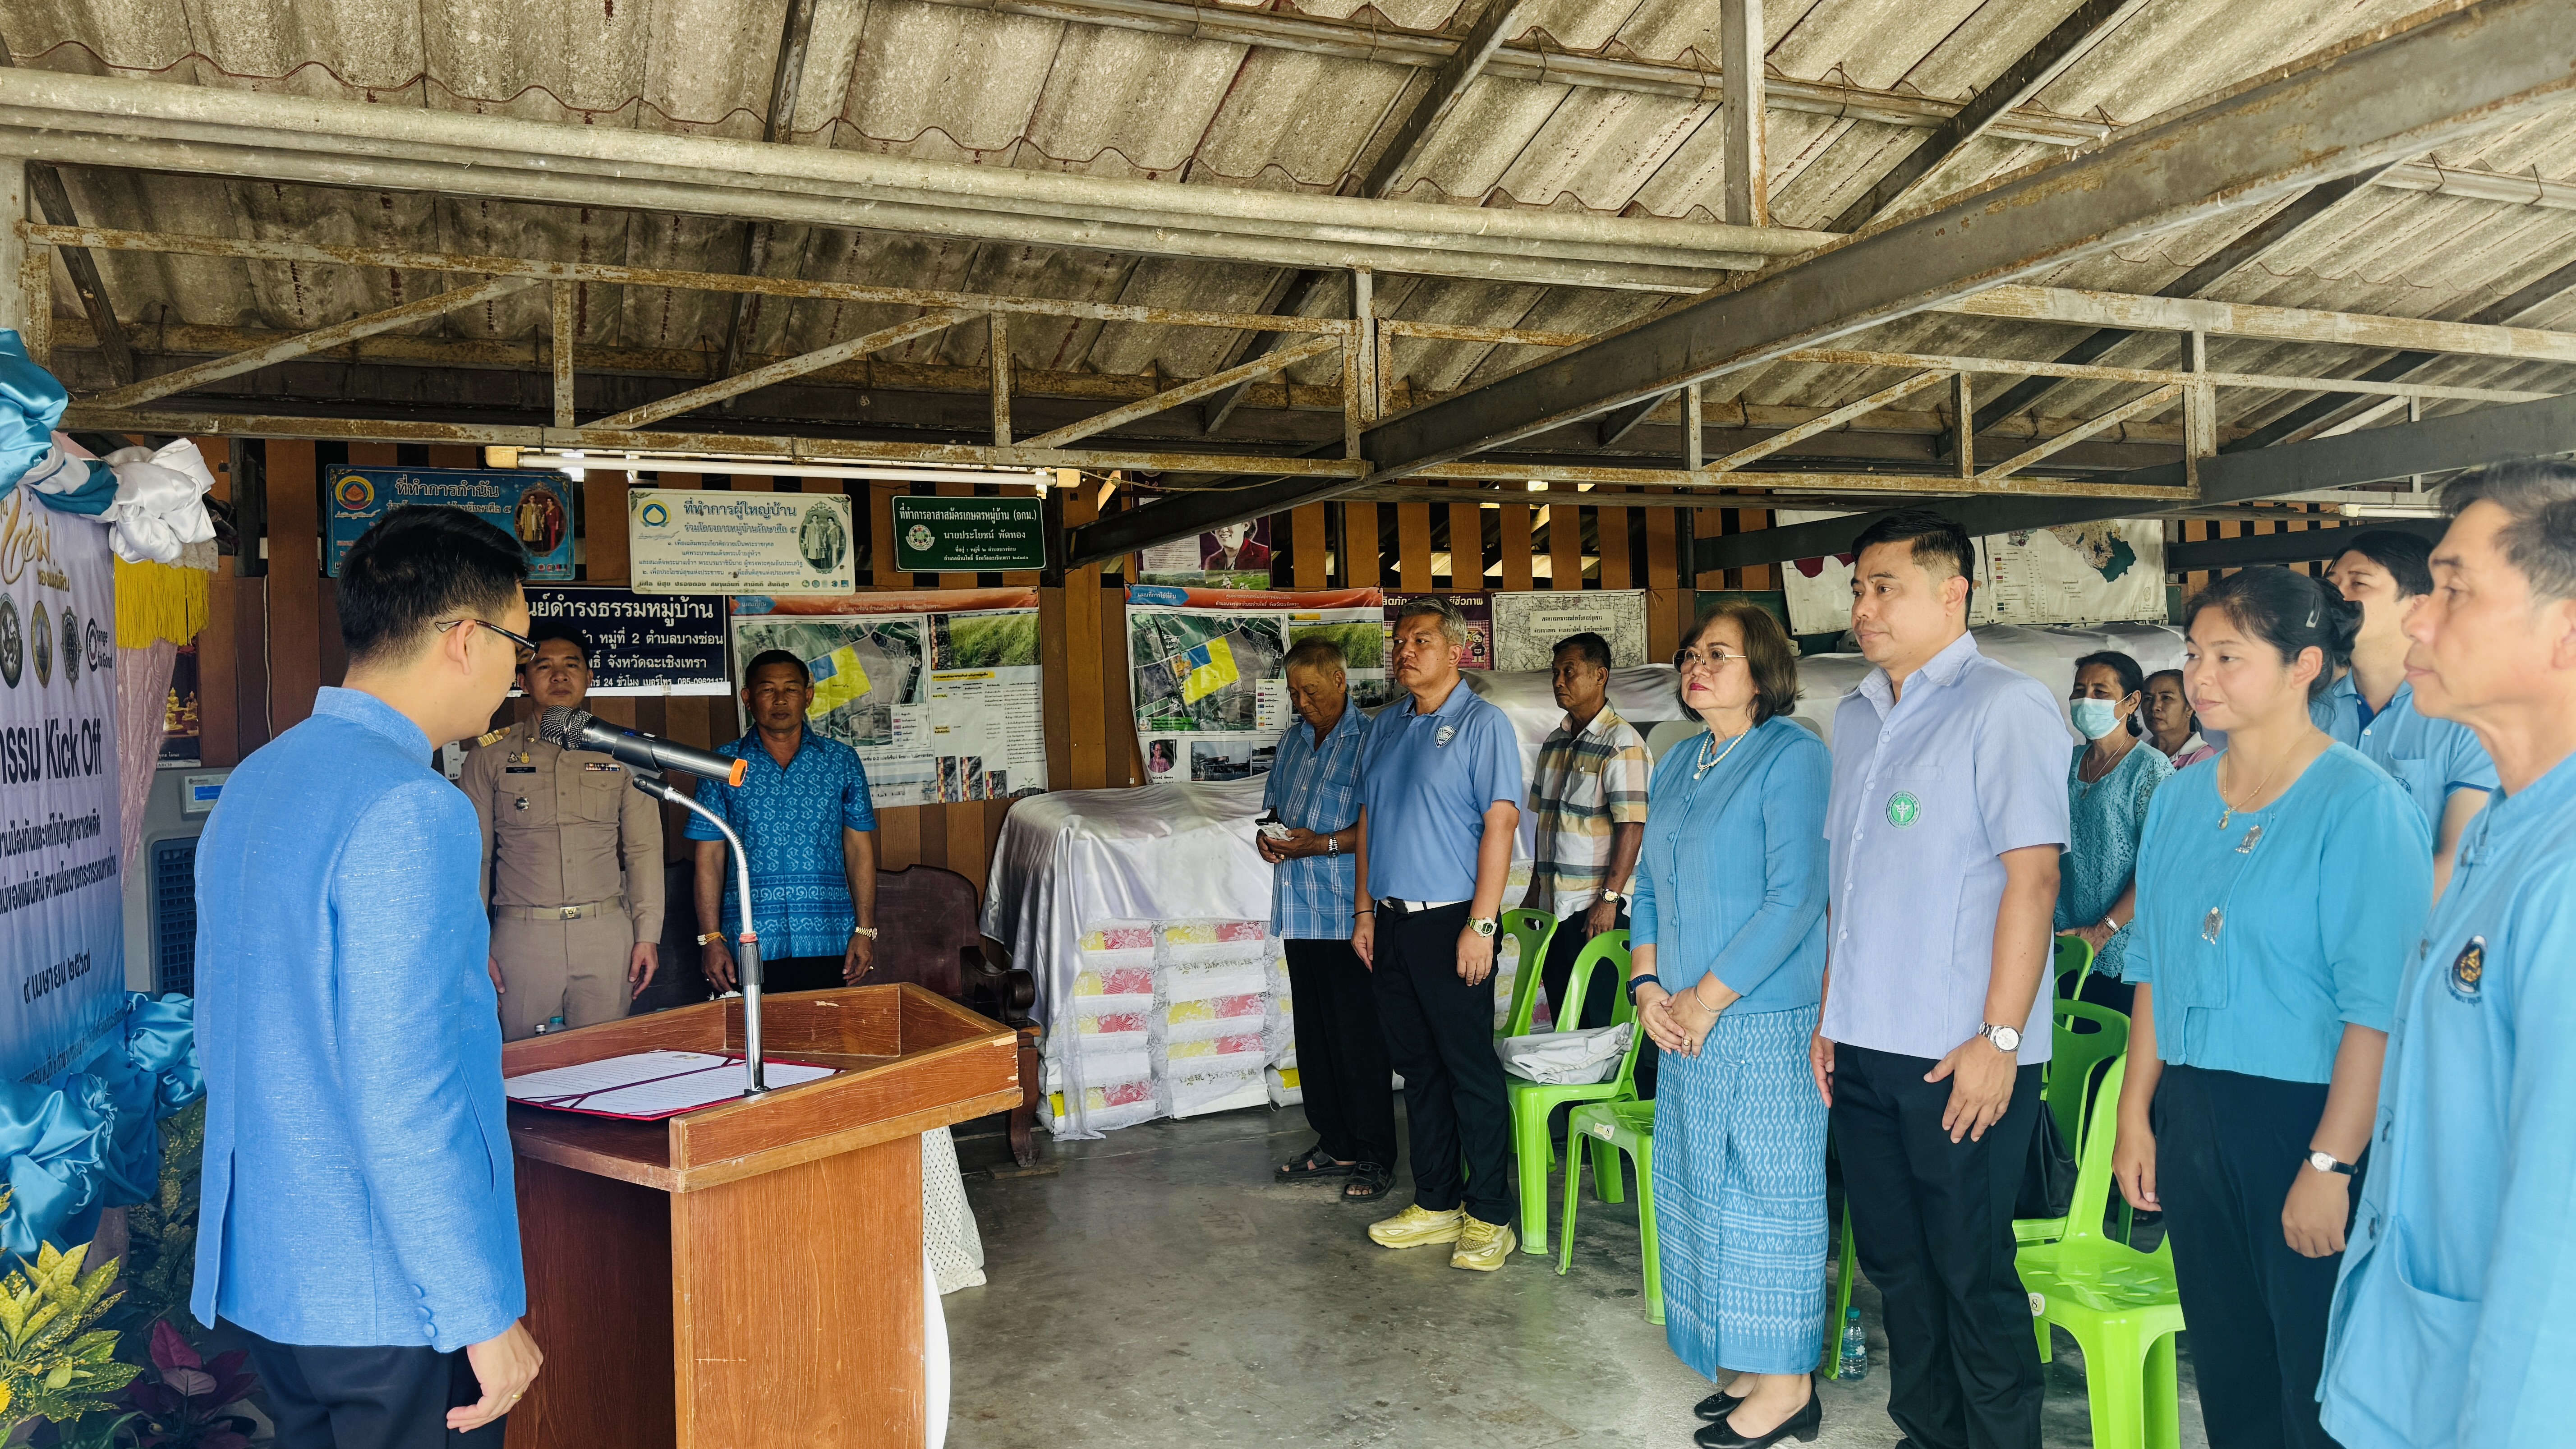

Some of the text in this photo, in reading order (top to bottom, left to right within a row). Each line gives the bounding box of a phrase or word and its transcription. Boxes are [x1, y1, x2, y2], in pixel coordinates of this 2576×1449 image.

[395, 474, 499, 498] ที่ทำการกำนัน
[683, 497, 797, 520] ที่ทำการผู้ใหญ่บ้าน
[899, 503, 1037, 524] ที่ทำการอาสาสมัครเกษตรหมู่บ้าน (อกม.)
[943, 529, 994, 539] นายประโยชน์
[526, 592, 713, 626] นย์ดำรงธรรมหมู่บ้าน
[599, 627, 625, 649] หมู่ที่
[632, 633, 639, 644] 2
[646, 629, 724, 644] ตำบลบางซ่อน
[607, 654, 707, 668] จังหวัดฉะเชิงเทรา
[604, 677, 613, 687] 24
[616, 673, 639, 687] ชั่วโมง
[45, 718, 80, 781] Kick
[82, 717, 102, 776] Off
[32, 961, 67, 1000] เมษายน
[68, 948, 91, 981] ๒๕๖๗
[2031, 1298, 2038, 1309] 8
